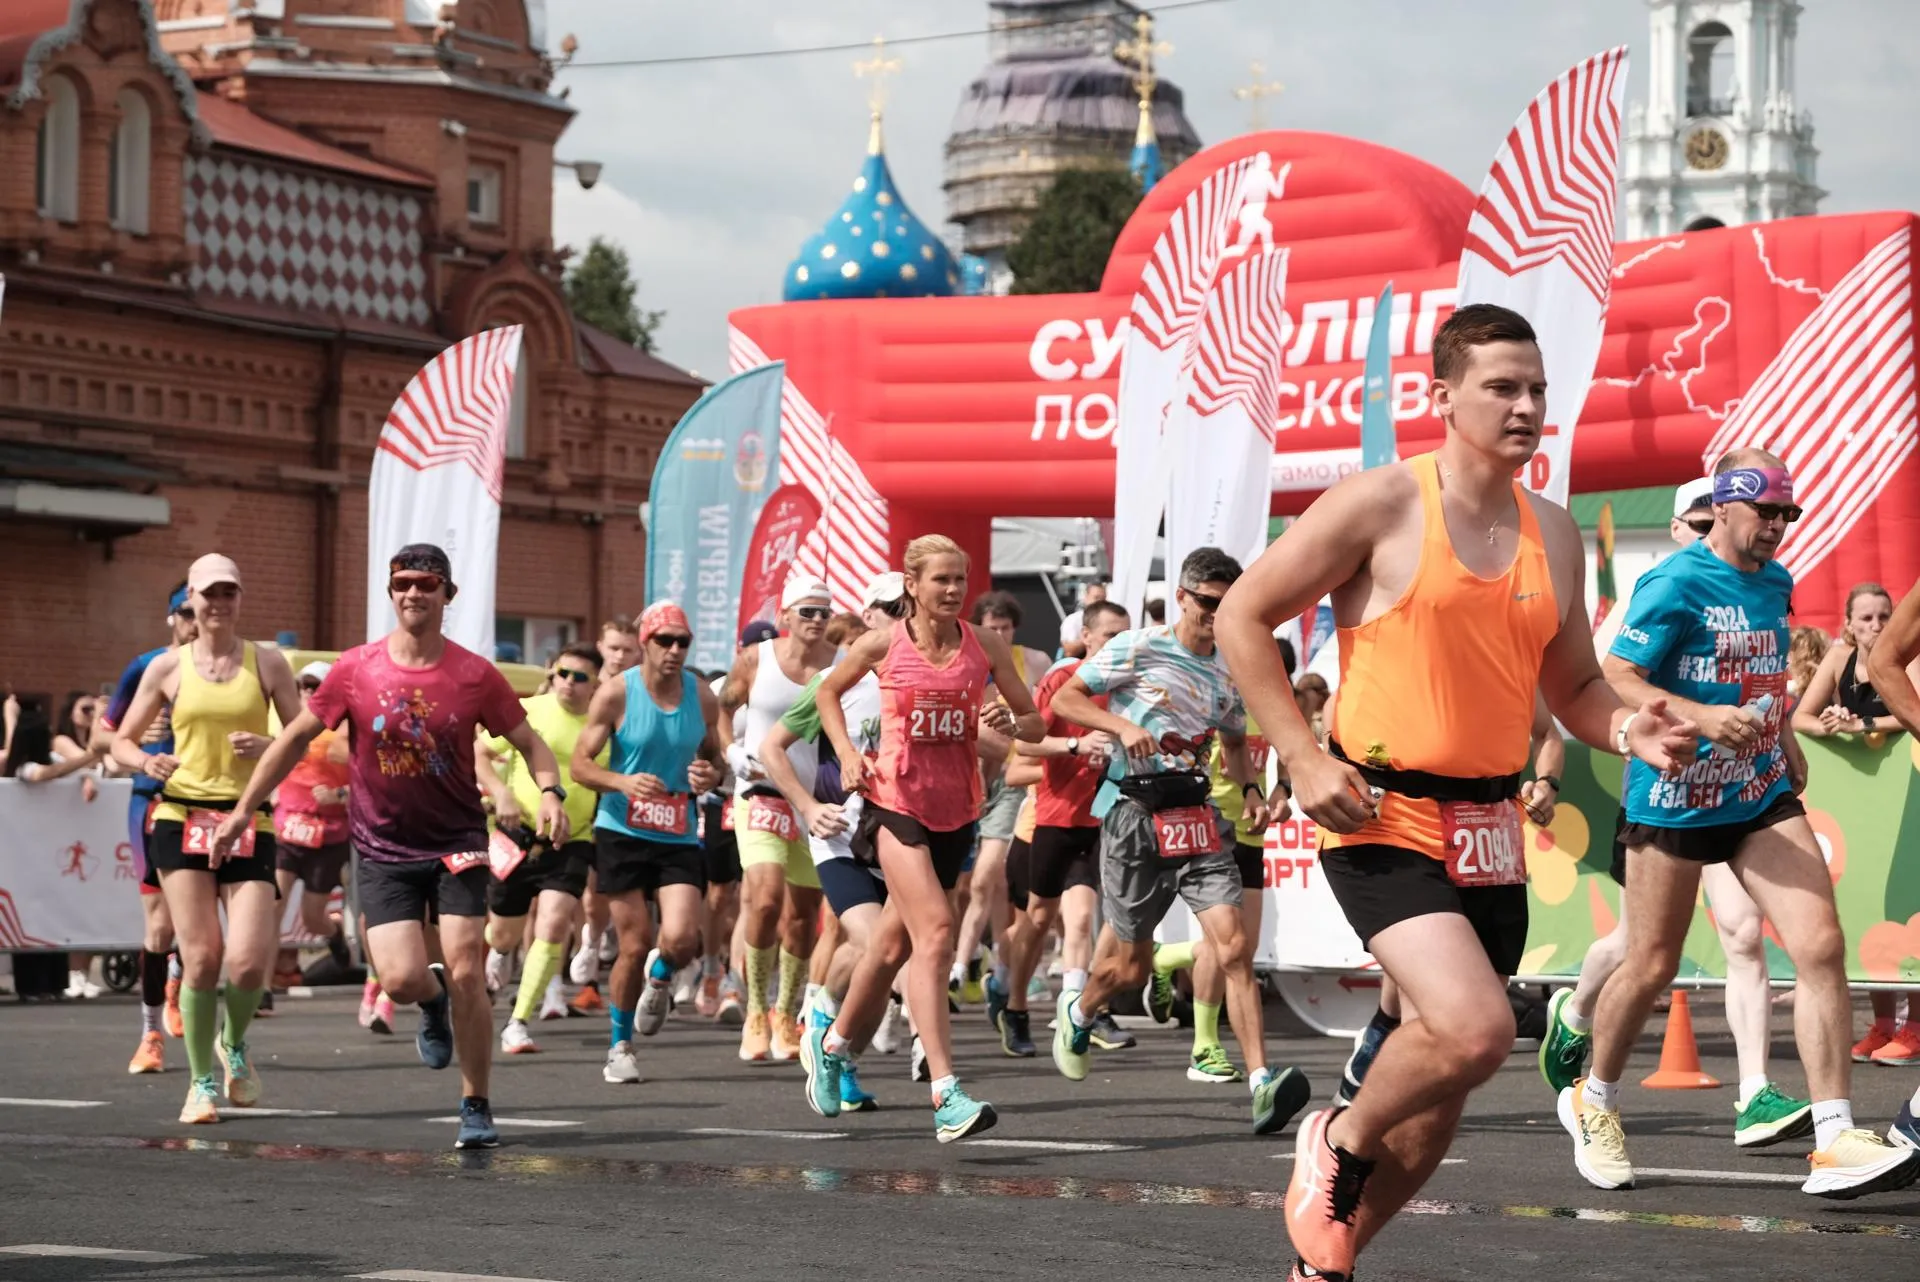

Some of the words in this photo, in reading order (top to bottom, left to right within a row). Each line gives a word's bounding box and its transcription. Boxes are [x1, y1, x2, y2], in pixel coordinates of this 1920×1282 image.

[1704, 606, 1750, 631] 2024
[1716, 630, 1778, 657] #МЕЧТА
[911, 709, 965, 736] 2143
[631, 800, 675, 826] 2369
[750, 807, 791, 833] 2278
[1162, 823, 1208, 849] 2210
[1453, 827, 1515, 874] 2094
[1578, 1113, 1592, 1147] HOKA
